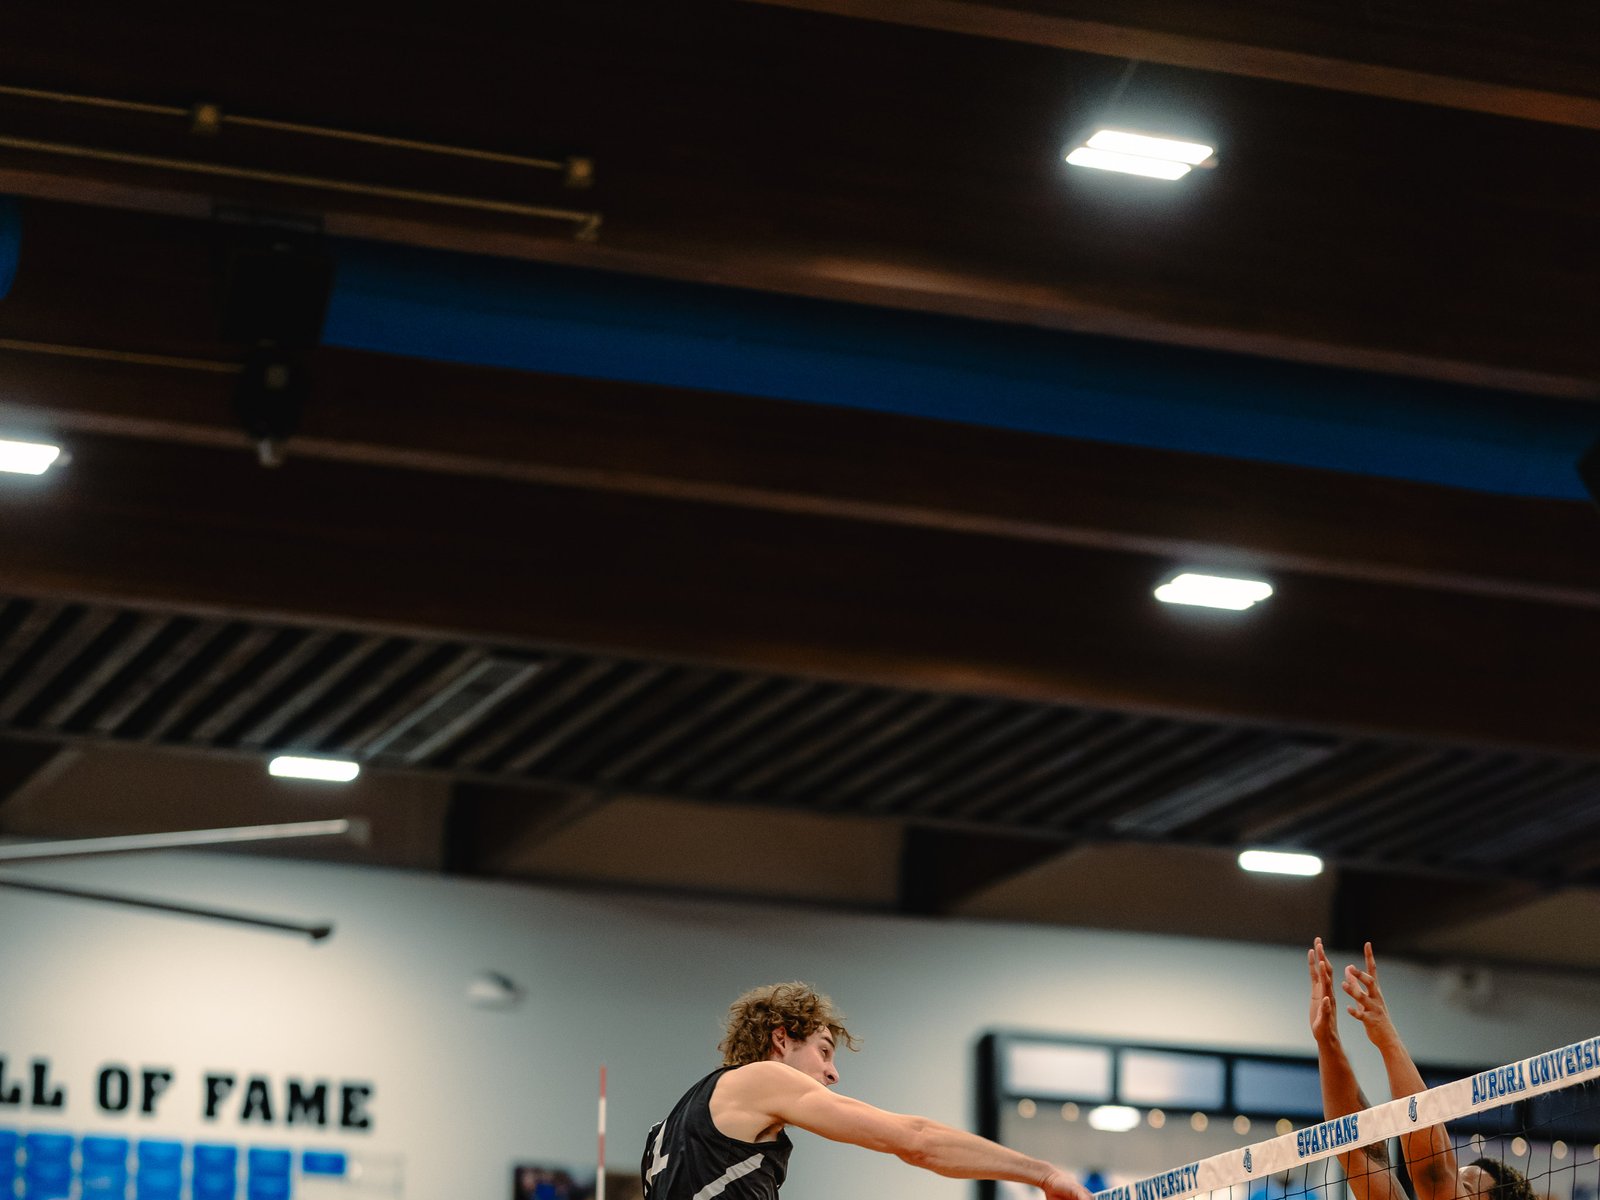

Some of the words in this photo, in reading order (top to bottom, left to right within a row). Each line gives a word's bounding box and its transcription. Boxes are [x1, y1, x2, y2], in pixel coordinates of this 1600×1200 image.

[97, 1066, 173, 1114] OF
[204, 1075, 371, 1129] FAME
[1472, 1062, 1526, 1105] AURORA
[1529, 1039, 1600, 1087] UNIVERSI
[1297, 1114, 1359, 1158] SPARTANS
